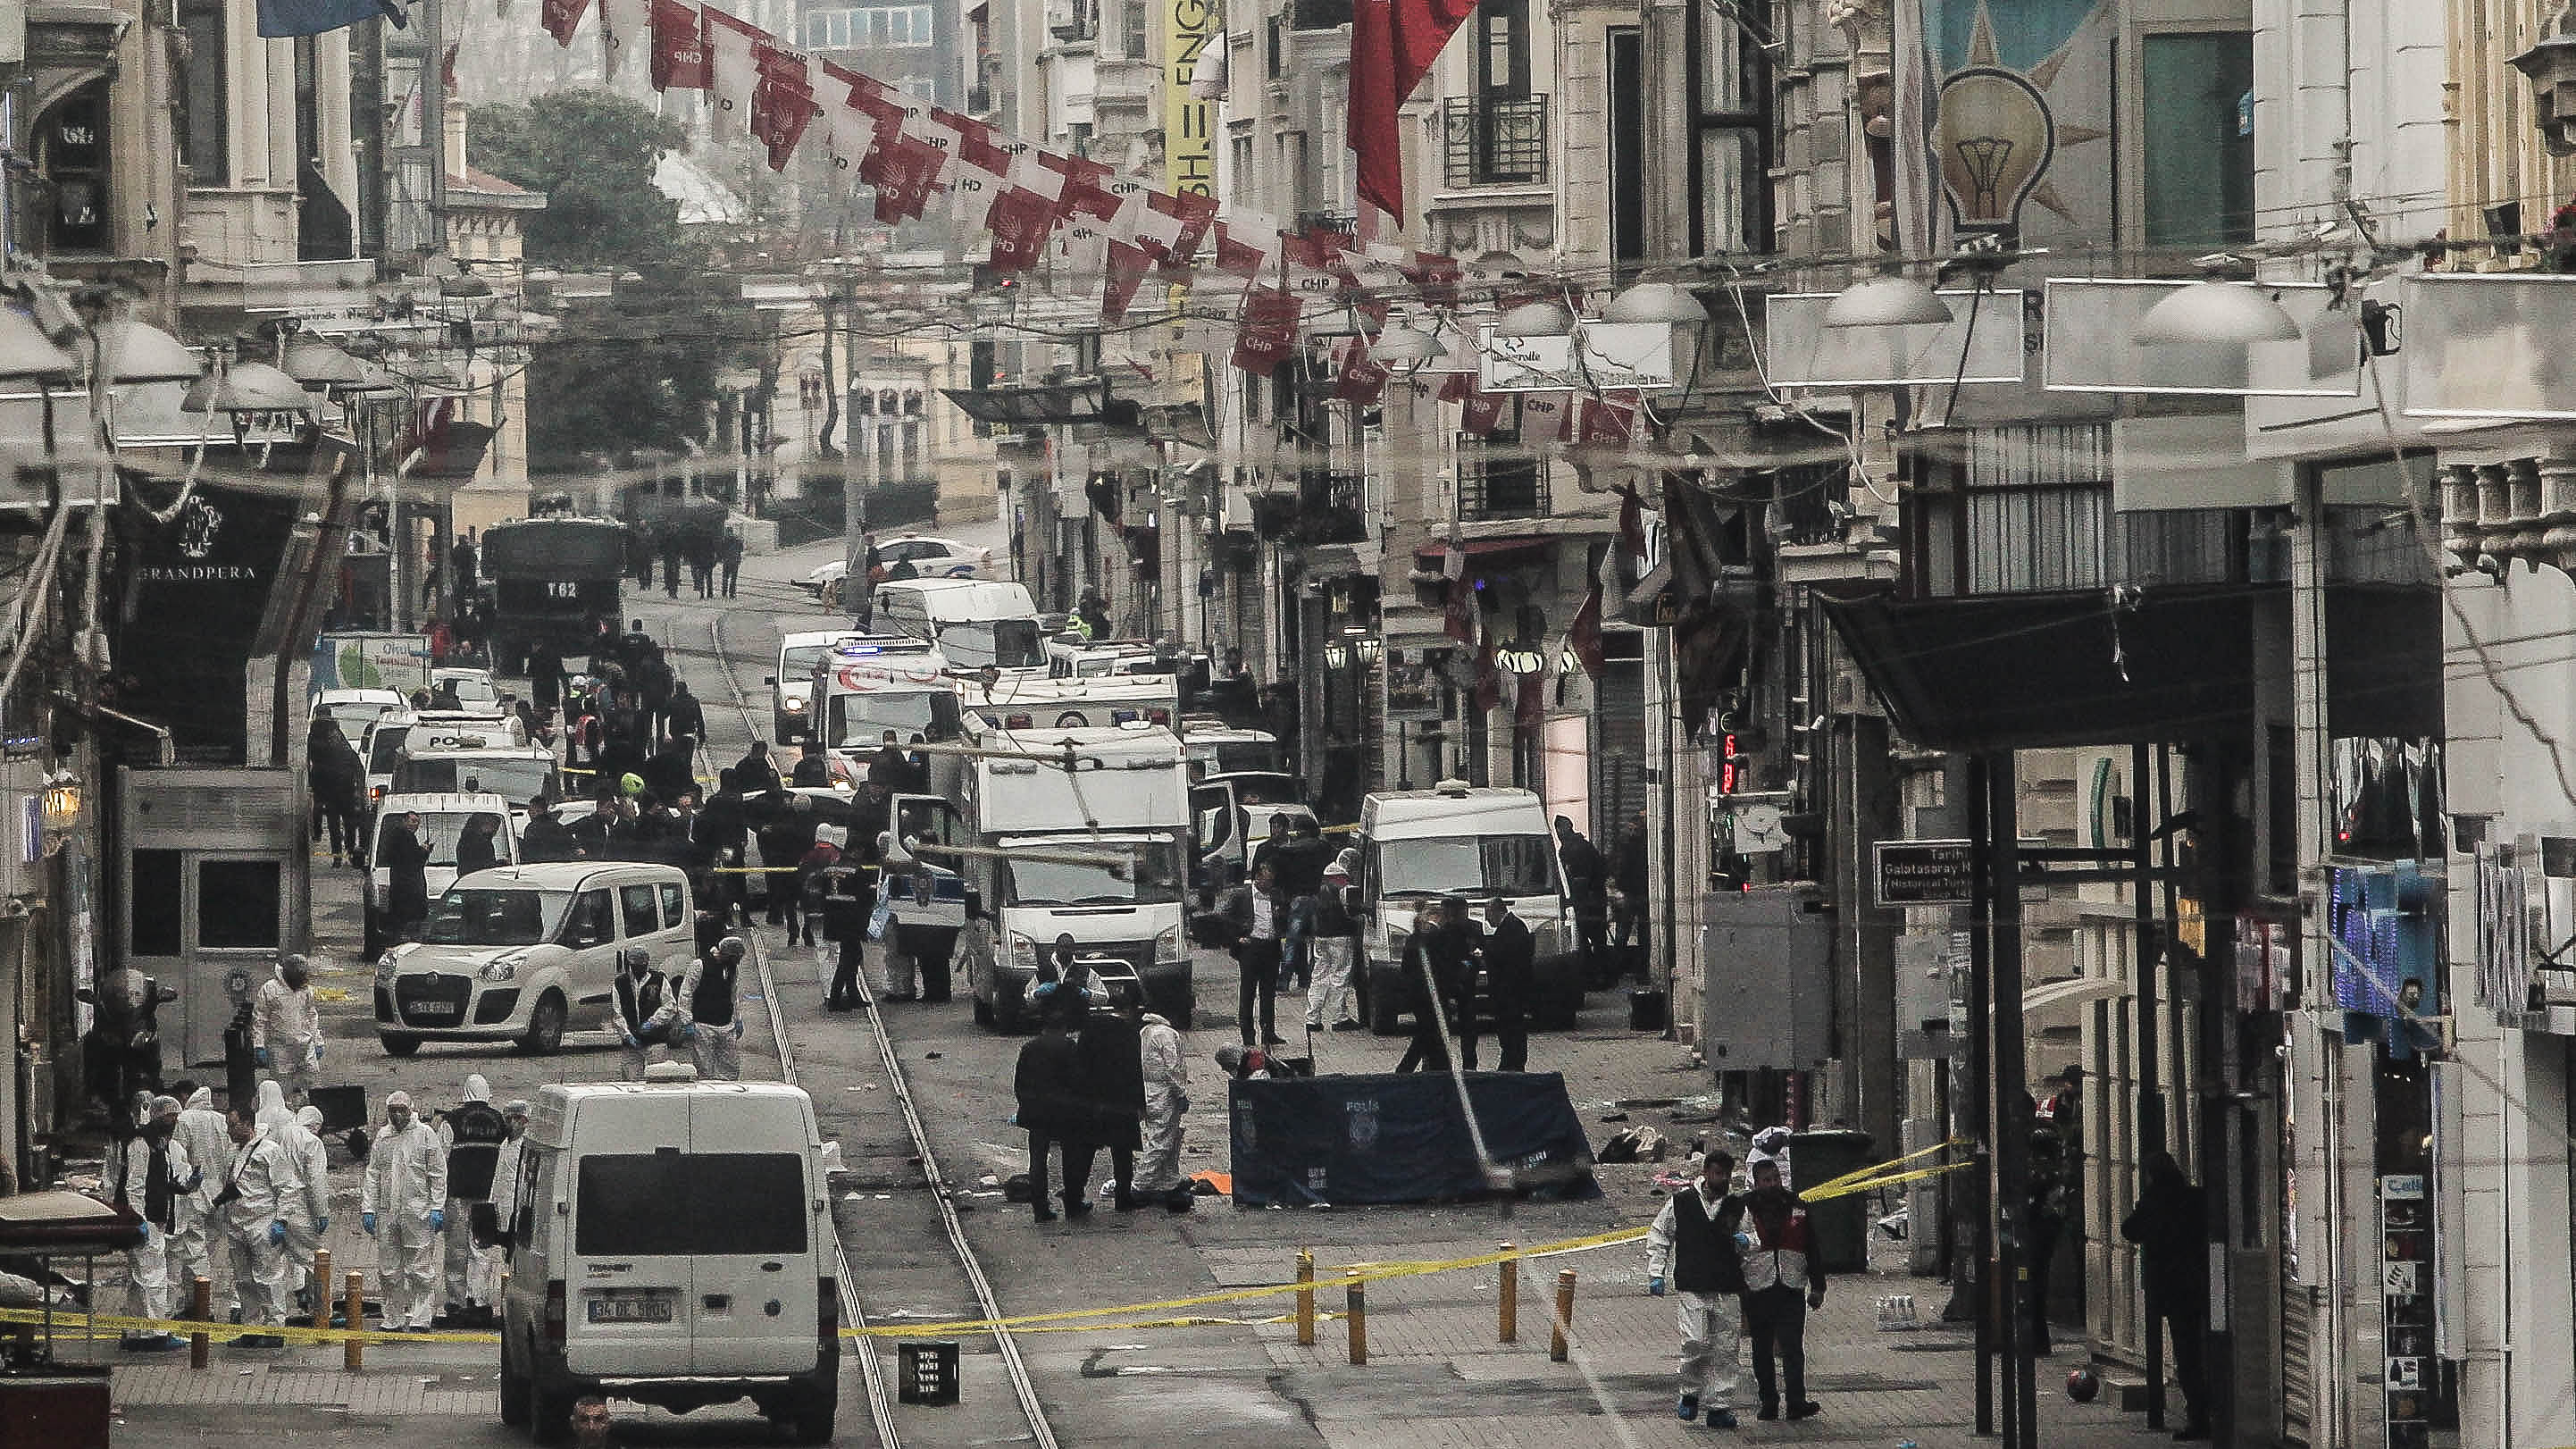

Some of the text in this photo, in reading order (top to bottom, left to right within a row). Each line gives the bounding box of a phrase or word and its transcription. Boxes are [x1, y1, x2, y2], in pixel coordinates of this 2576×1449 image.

[927, 137, 949, 150] HP
[1111, 183, 1140, 194] CHP
[1301, 277, 1330, 289] CHP
